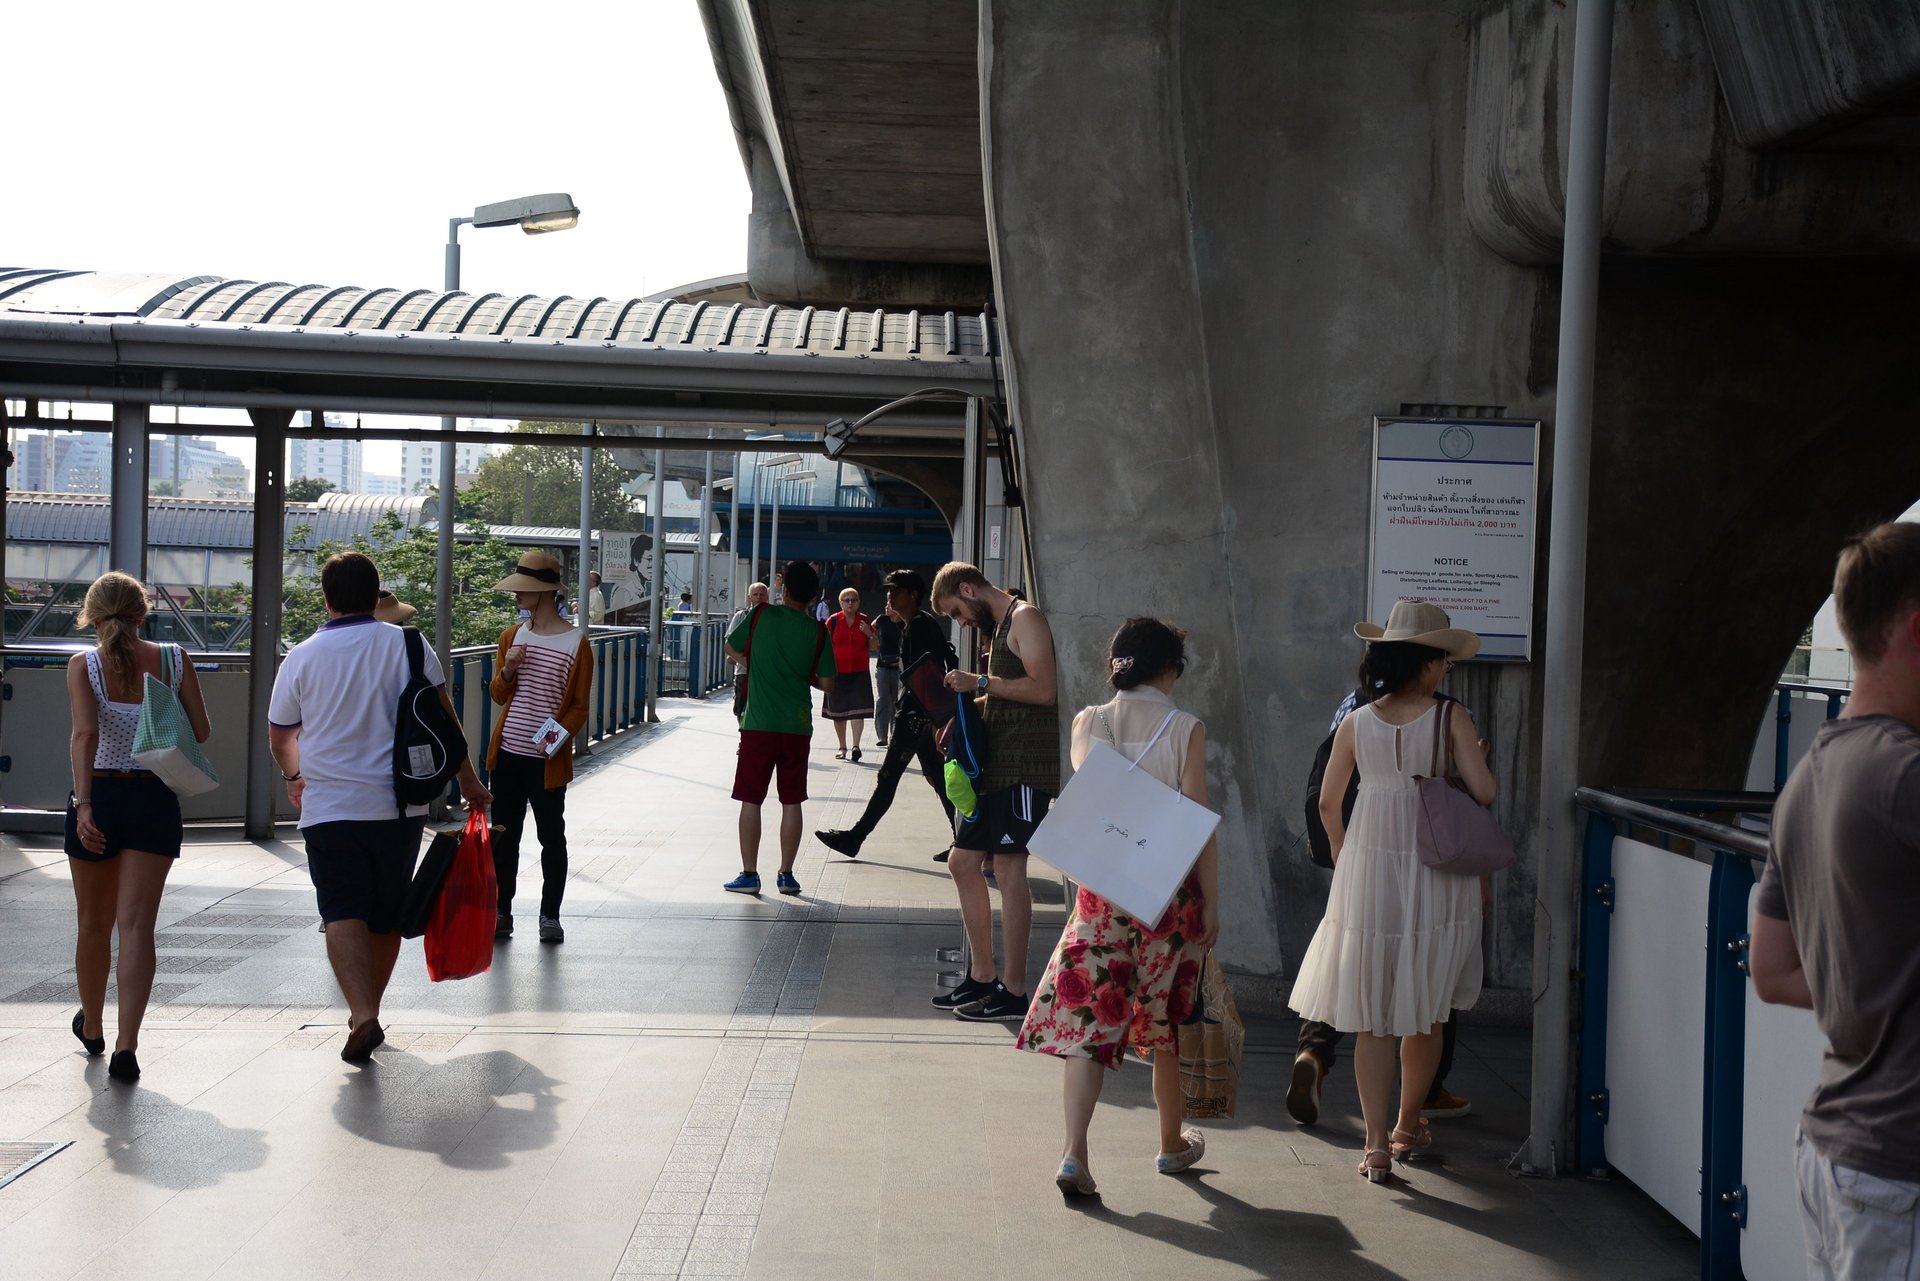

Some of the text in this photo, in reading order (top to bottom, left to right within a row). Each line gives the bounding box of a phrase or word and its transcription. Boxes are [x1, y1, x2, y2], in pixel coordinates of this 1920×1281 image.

[1437, 476, 1472, 485] ประกาศ
[1383, 492, 1526, 504] ห้ามจำหน่ายสินค้า ตั้งวางสิ่งของ เล่นกีฬา
[1388, 503, 1520, 516] แจกใบปลิว นั่งหรือนอน ในที่สาธารณะ
